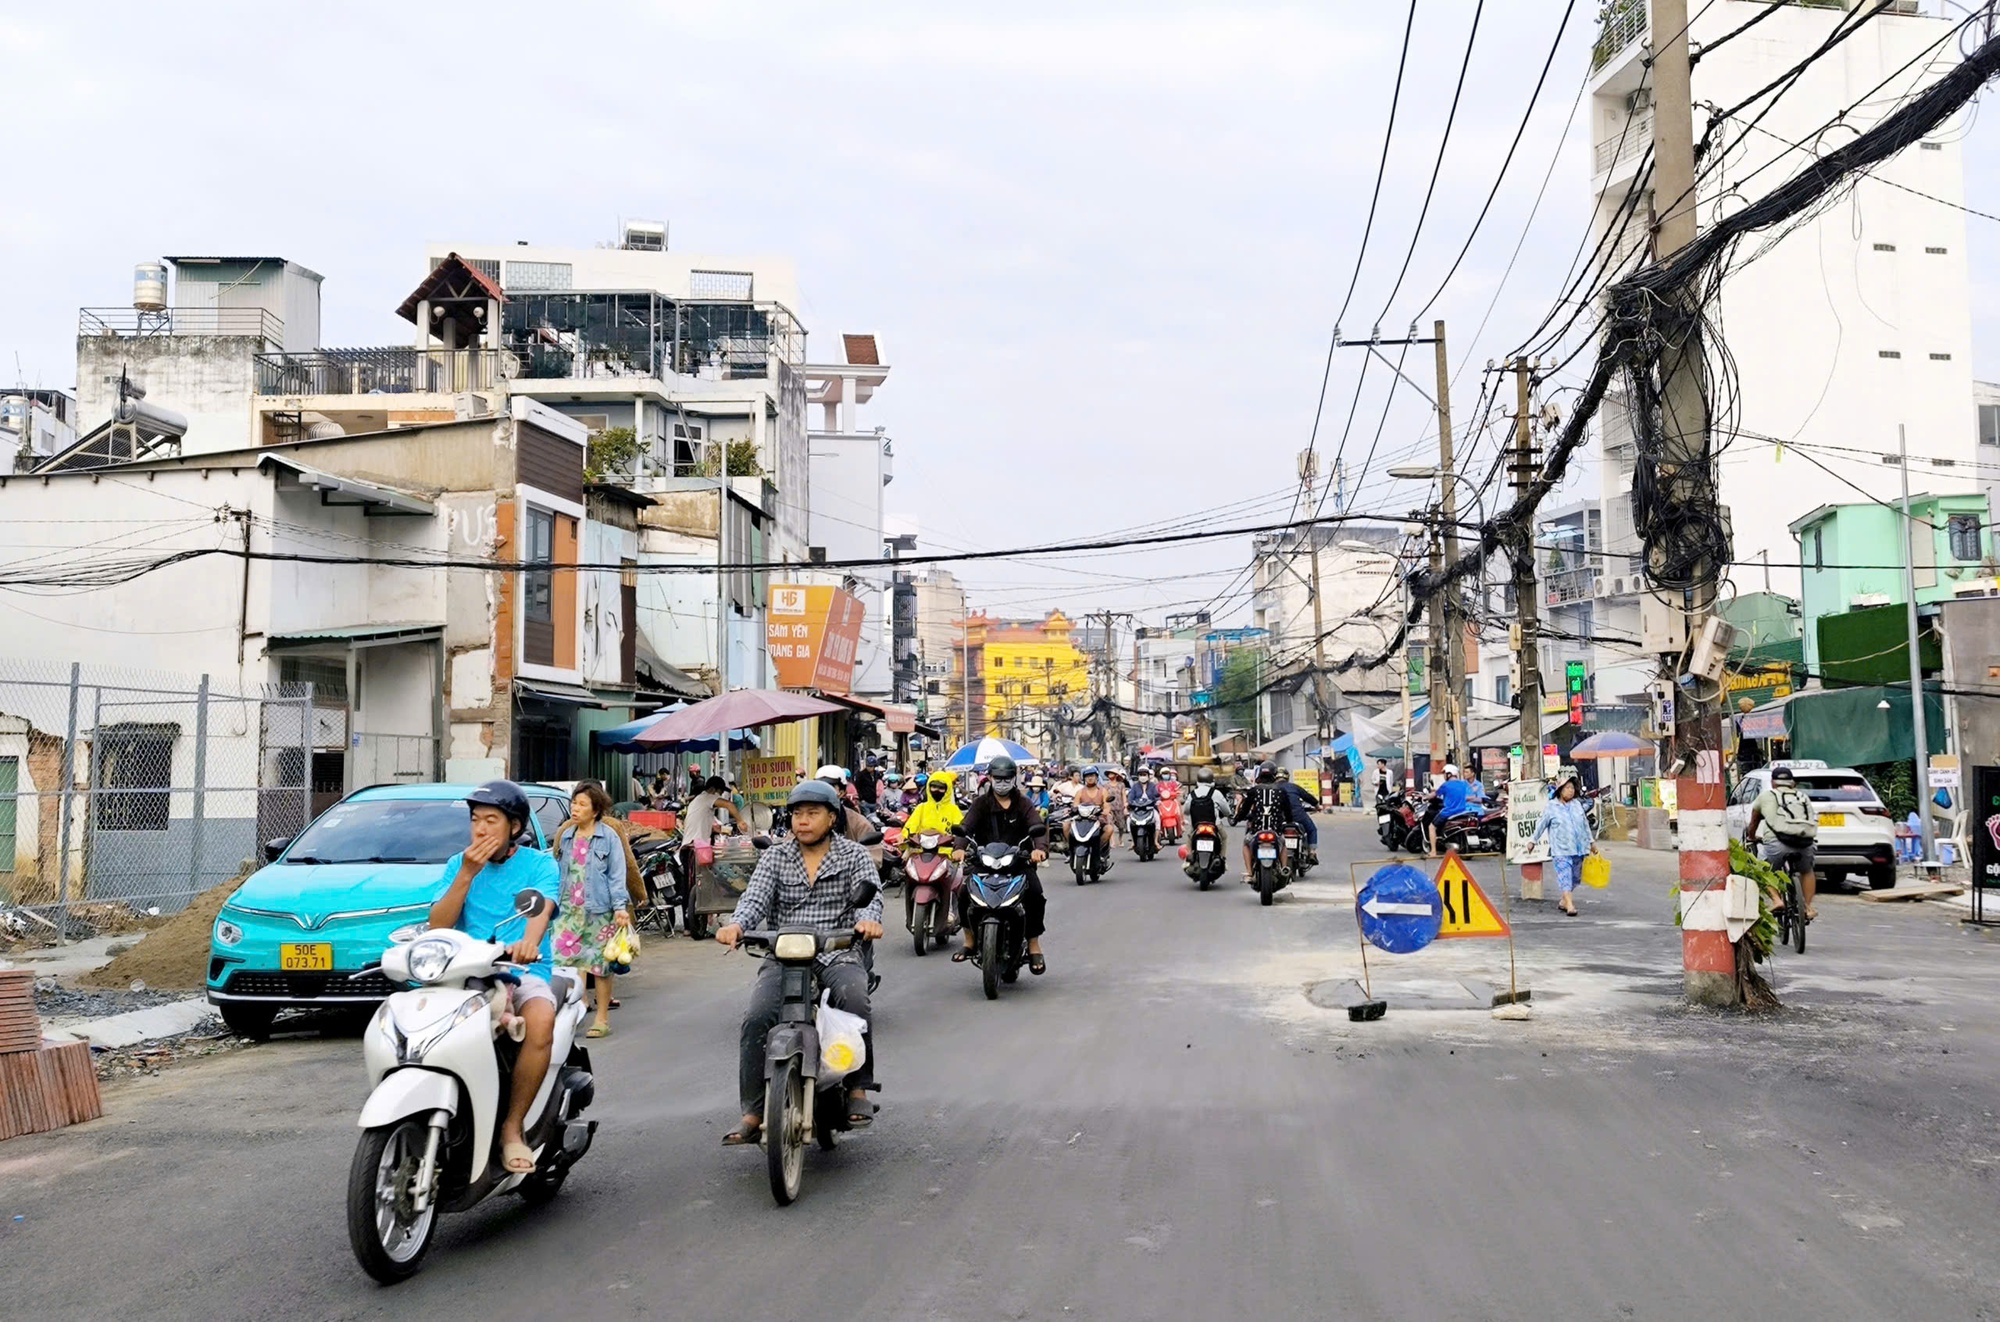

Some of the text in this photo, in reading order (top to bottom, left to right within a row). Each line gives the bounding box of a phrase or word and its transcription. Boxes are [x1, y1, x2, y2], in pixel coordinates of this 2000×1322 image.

[796, 645, 810, 658] GIA
[771, 776, 793, 787] CUA
[294, 944, 317, 955] 50E
[286, 957, 325, 968] 073.71
